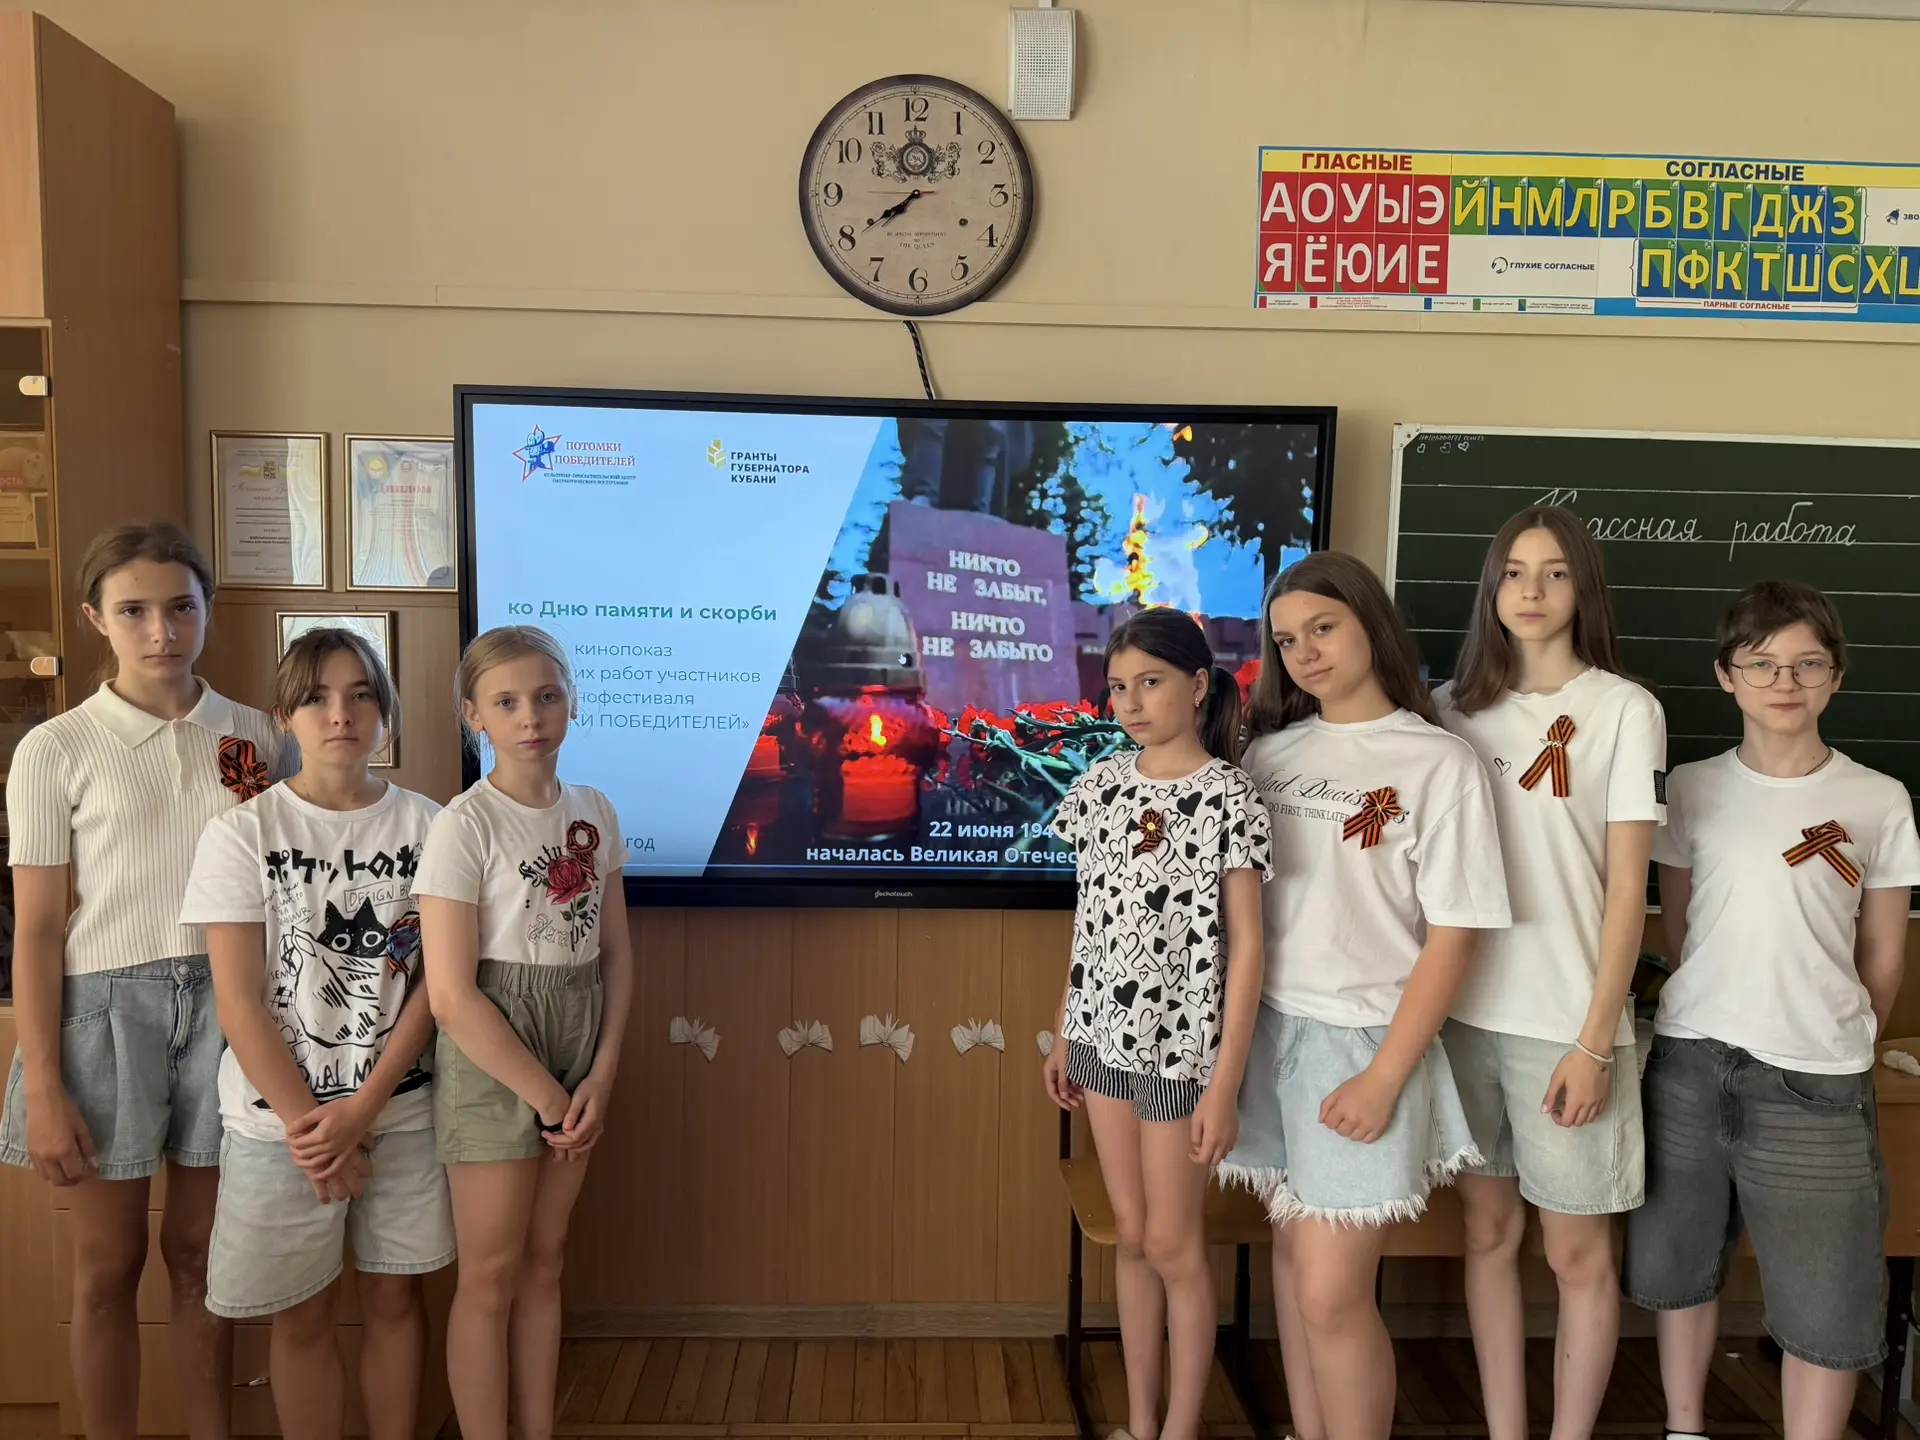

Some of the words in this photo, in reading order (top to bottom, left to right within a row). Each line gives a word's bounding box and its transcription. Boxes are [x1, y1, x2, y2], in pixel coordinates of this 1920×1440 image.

[902, 97, 929, 122] 12
[865, 111, 884, 135] 11
[953, 111, 963, 135] 1
[835, 137, 862, 164] 10
[977, 140, 996, 165] 2
[1301, 153, 1412, 171] ГЛАСНЫЕ
[1665, 160, 1805, 182] СОГЛАСНЫЕ
[823, 182, 843, 207] 9
[988, 183, 1009, 207] 3
[838, 225, 856, 251] 8
[976, 223, 998, 248] 4
[868, 256, 884, 282] 7
[951, 254, 969, 281] 5
[1544, 262, 1595, 270] СОГЛАСНЫЕ
[908, 267, 929, 293] 6
[1703, 300, 1737, 308] ПАРНЫЕ
[1740, 302, 1790, 310] СОГЛАСНЫЕ
[566, 441, 621, 452] ПОТОМКИ
[731, 452, 777, 461] ГРАНТЫ
[555, 454, 636, 466] ПОБЕДИТЕЛЕЙ
[731, 463, 810, 473] ГУБЕРНАТОРА
[731, 474, 776, 483] КУБАНИ
[1729, 501, 1857, 562] работа
[949, 550, 1021, 577] НИКТО
[927, 571, 957, 593] НЕ
[974, 578, 1047, 606] ЗАБЫТ,
[508, 602, 534, 615] ко
[540, 601, 588, 618] Дню
[595, 603, 673, 619] памяти
[680, 607, 693, 619] и
[699, 605, 777, 623] скорби
[951, 611, 1025, 636] НИЧТО
[575, 644, 672, 657] кинопоказ
[922, 636, 954, 657] НЕ
[969, 639, 1053, 662] ЗАБЫТО
[600, 665, 653, 682] работ
[657, 670, 761, 683] участников
[600, 713, 750, 731] ПОБЕДИТЕЛЕЙ»
[1268, 802, 1279, 812] DO
[1304, 807, 1326, 819] THINK
[929, 821, 952, 838] 22
[957, 824, 1014, 838] июня
[626, 838, 655, 852] год
[806, 848, 905, 862] началась
[910, 846, 998, 862] Великая
